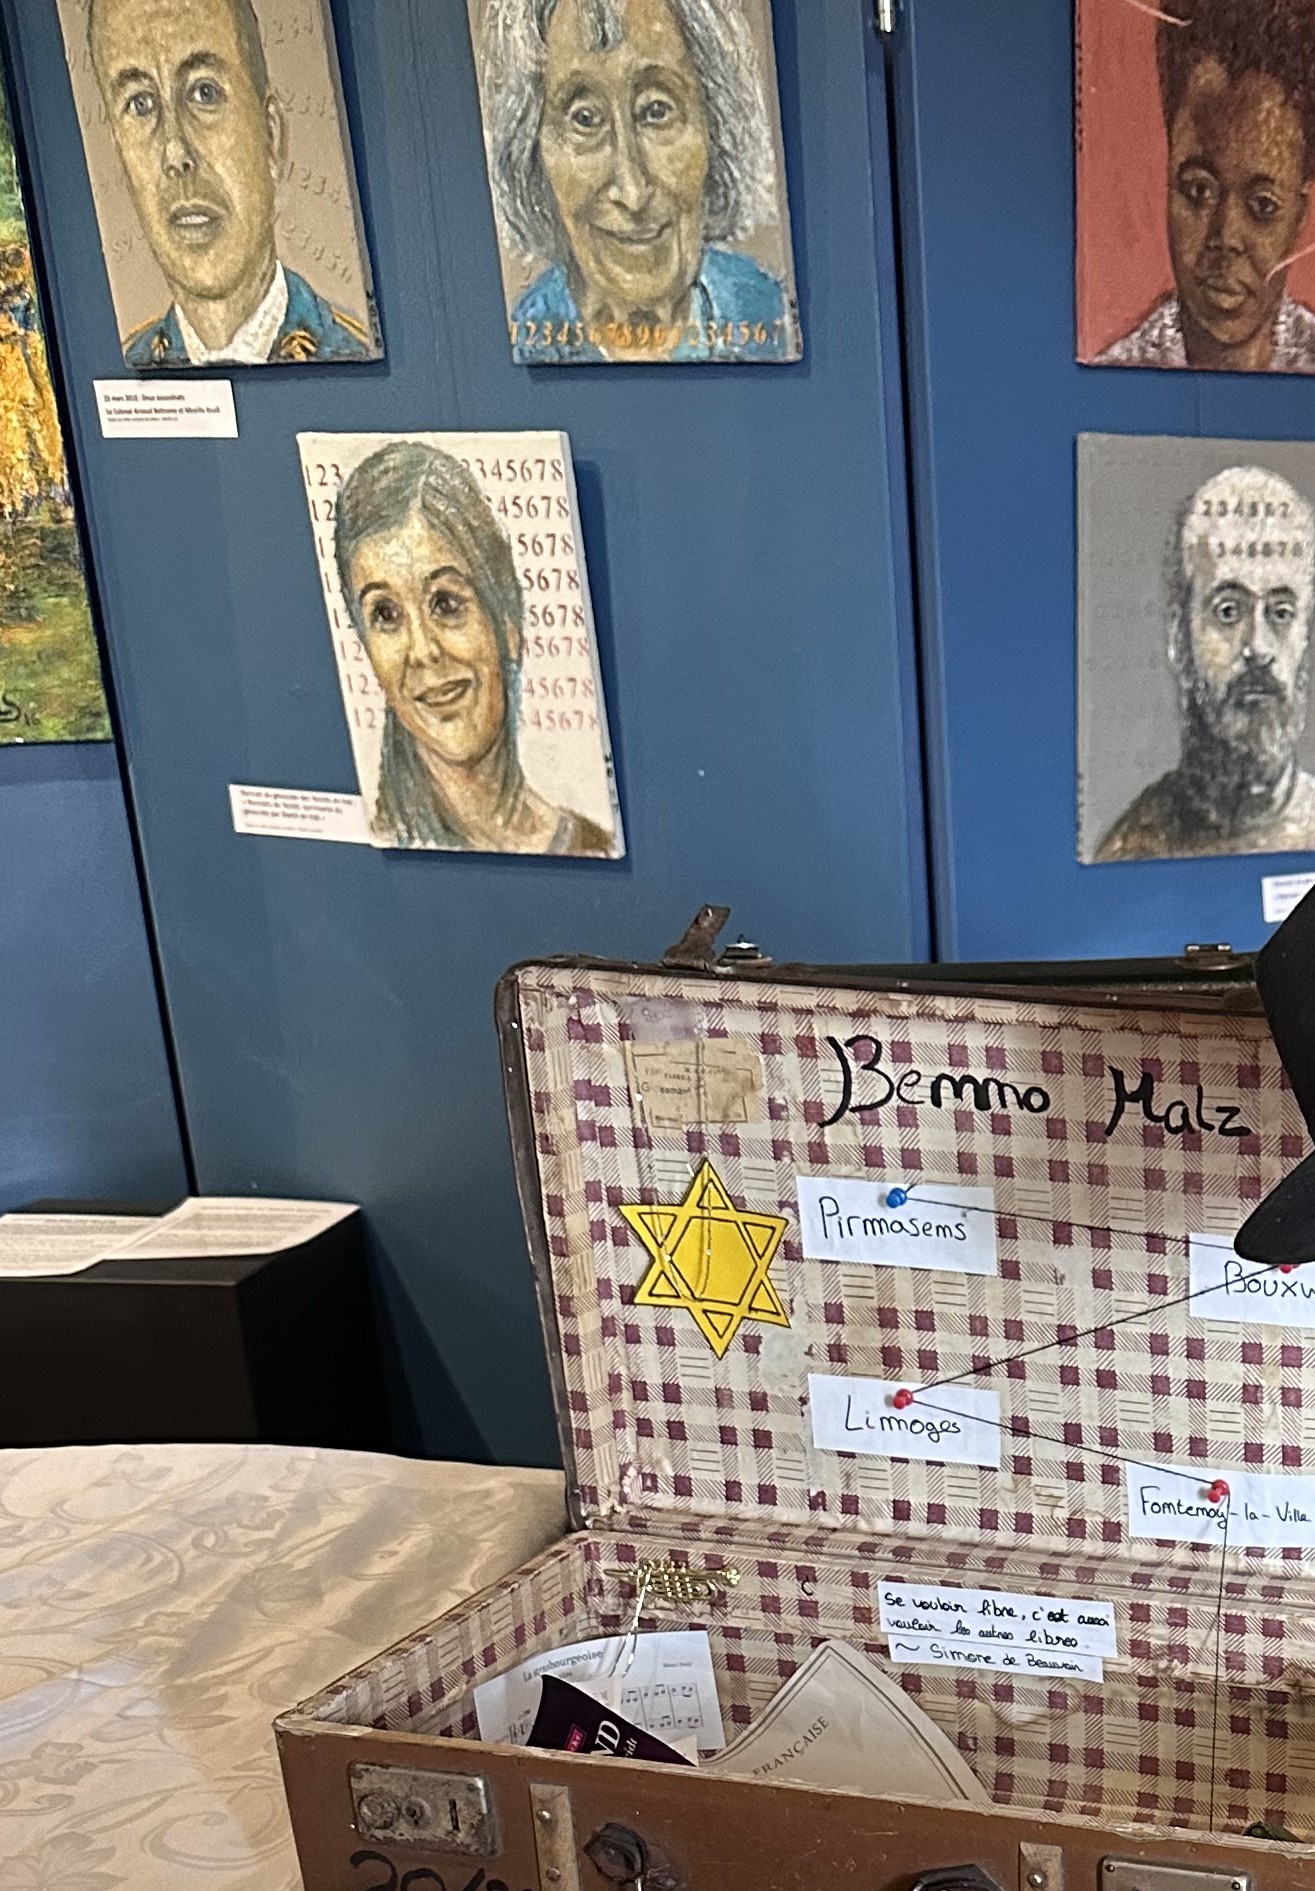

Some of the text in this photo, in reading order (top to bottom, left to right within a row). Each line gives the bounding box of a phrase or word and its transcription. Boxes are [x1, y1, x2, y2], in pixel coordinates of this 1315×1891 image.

[305, 463, 342, 487] 123
[311, 500, 335, 521] 12
[508, 533, 574, 557] 5678
[522, 568, 579, 592] 5678
[529, 604, 586, 627] 5678
[845, 1394, 961, 1443] Limoges
[912, 1598, 968, 1614] vouloir
[887, 1617, 942, 1633] vouloir
[1003, 1655, 1020, 1666] de
